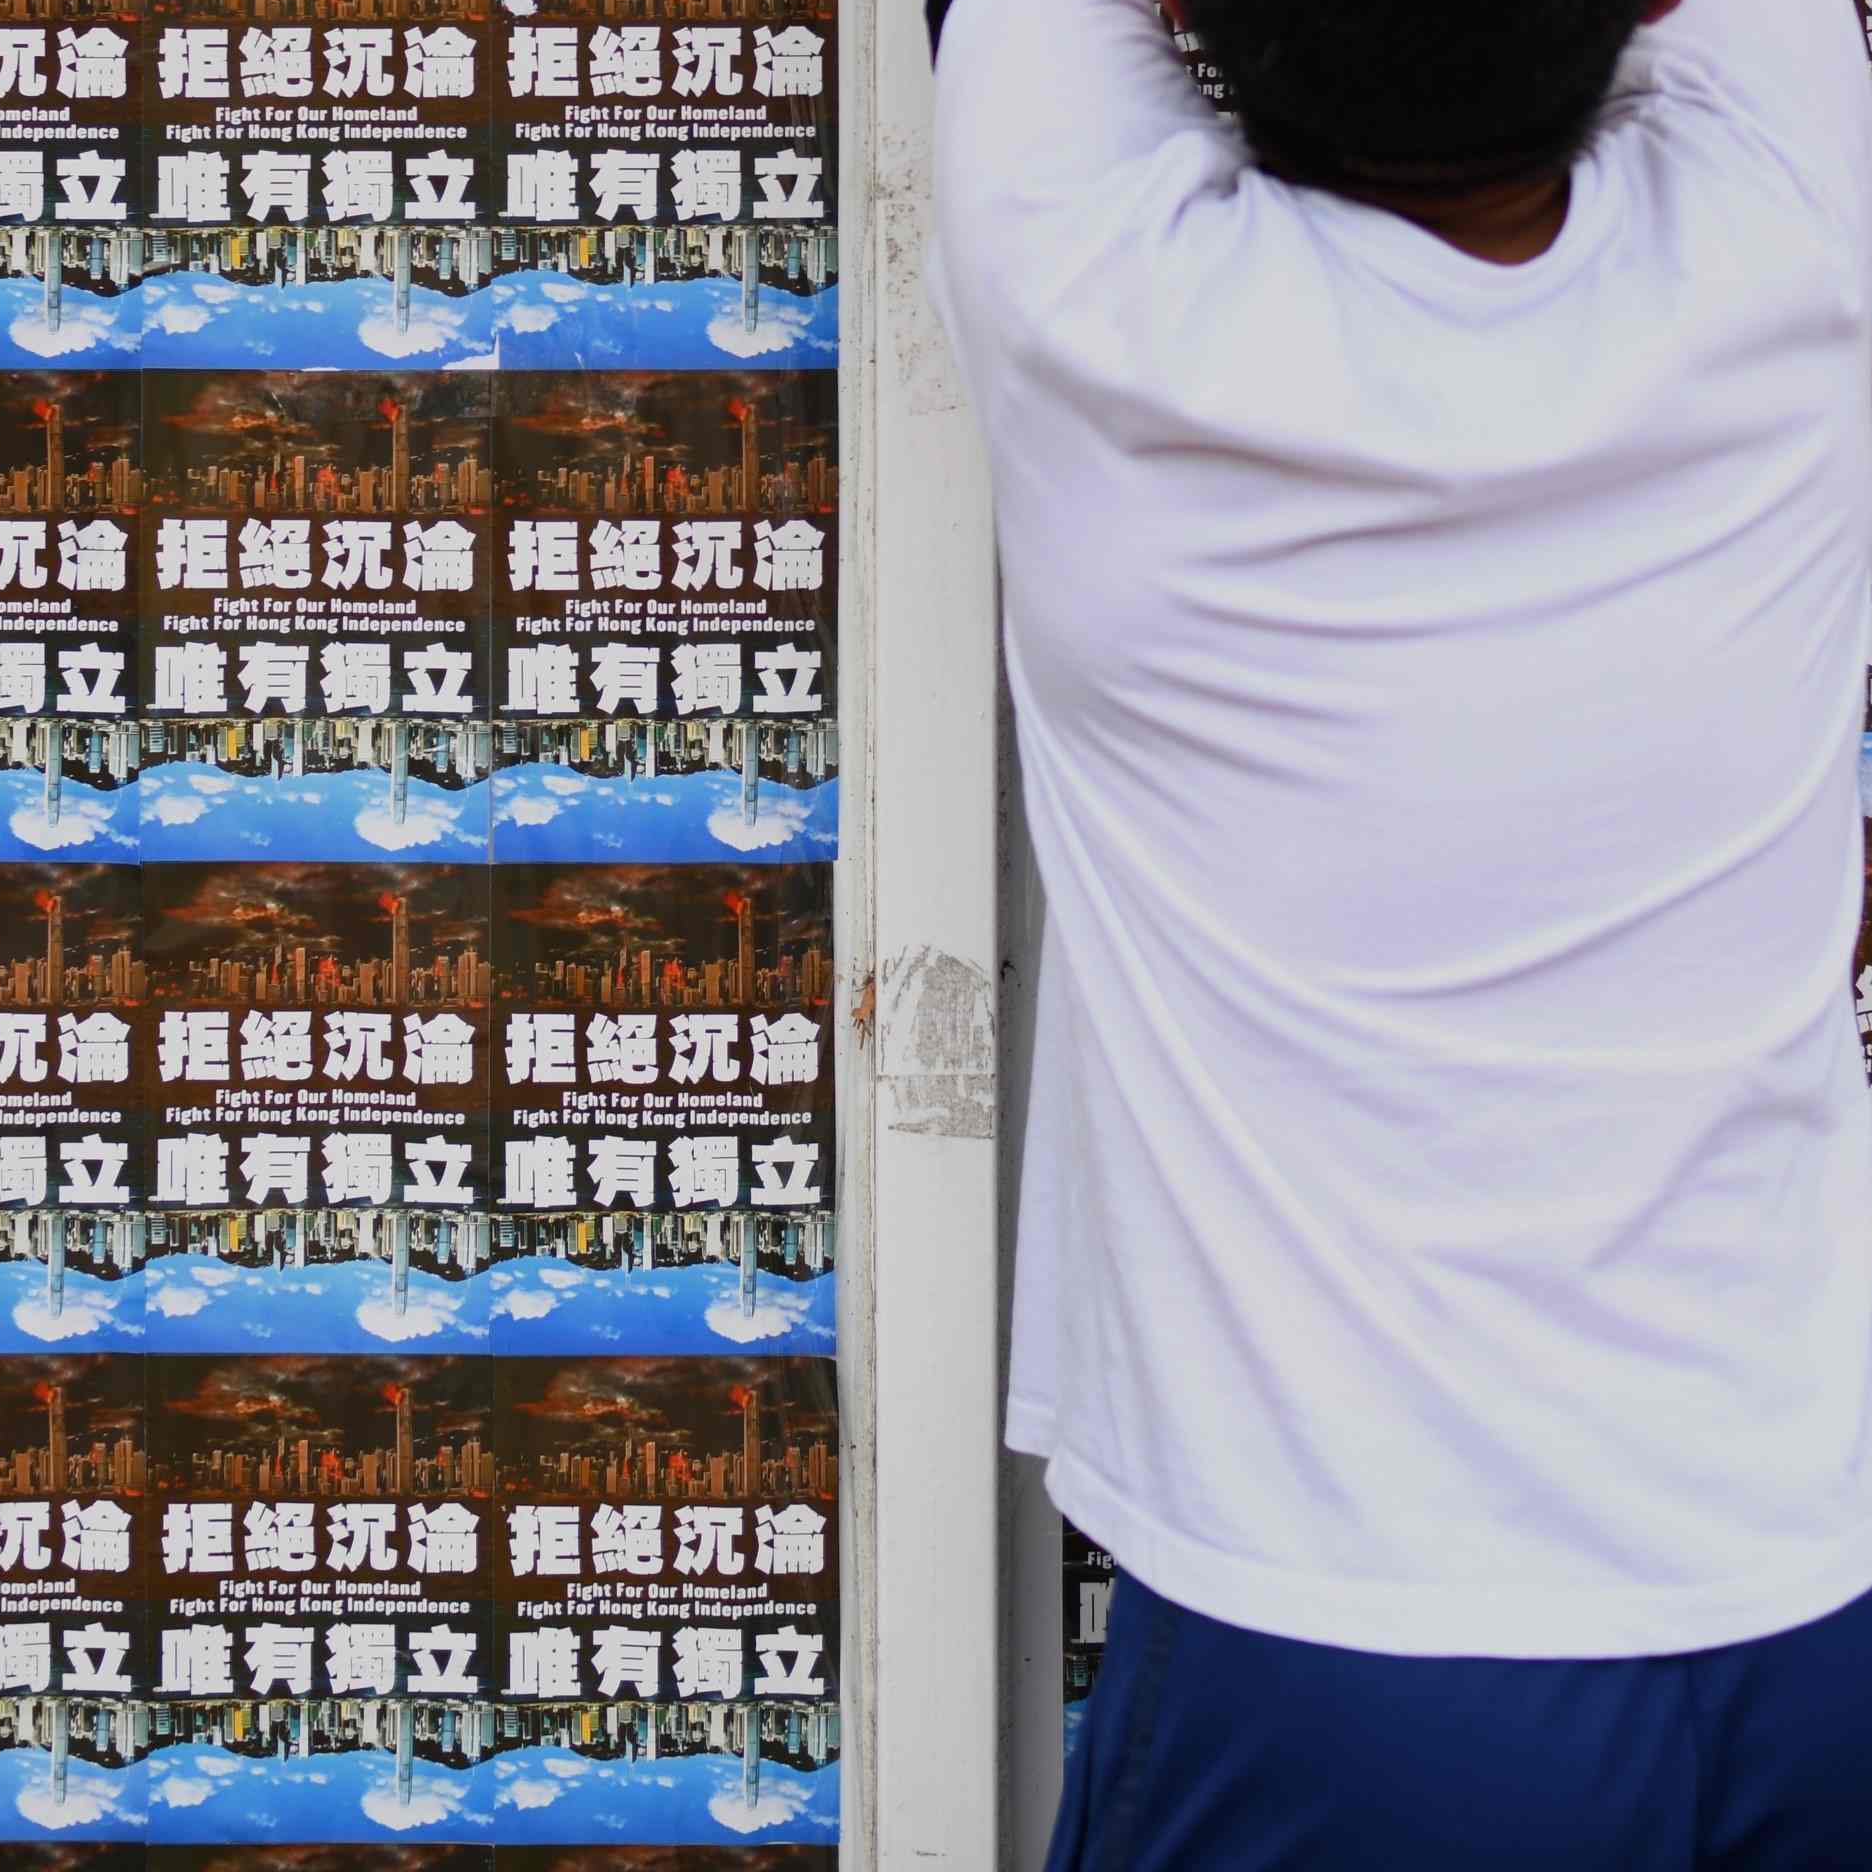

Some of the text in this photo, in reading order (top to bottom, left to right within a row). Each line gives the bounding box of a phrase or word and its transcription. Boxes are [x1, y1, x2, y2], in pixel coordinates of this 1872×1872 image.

[507, 26, 824, 97] 拒絕沉淪
[505, 149, 823, 221] 唯有獨立
[156, 518, 476, 591] 拒絕沉淪
[154, 641, 473, 713] 唯有獨立
[505, 1013, 820, 1085] 拒絕沉淪
[503, 1135, 820, 1208] 唯有獨立
[162, 1501, 479, 1573] 拒絕沉淪
[170, 1599, 470, 1616] Fight For Hong Kong Independence
[219, 1580, 421, 1597] Fight For Our Homeland
[160, 1623, 478, 1695] 唯有獨立
